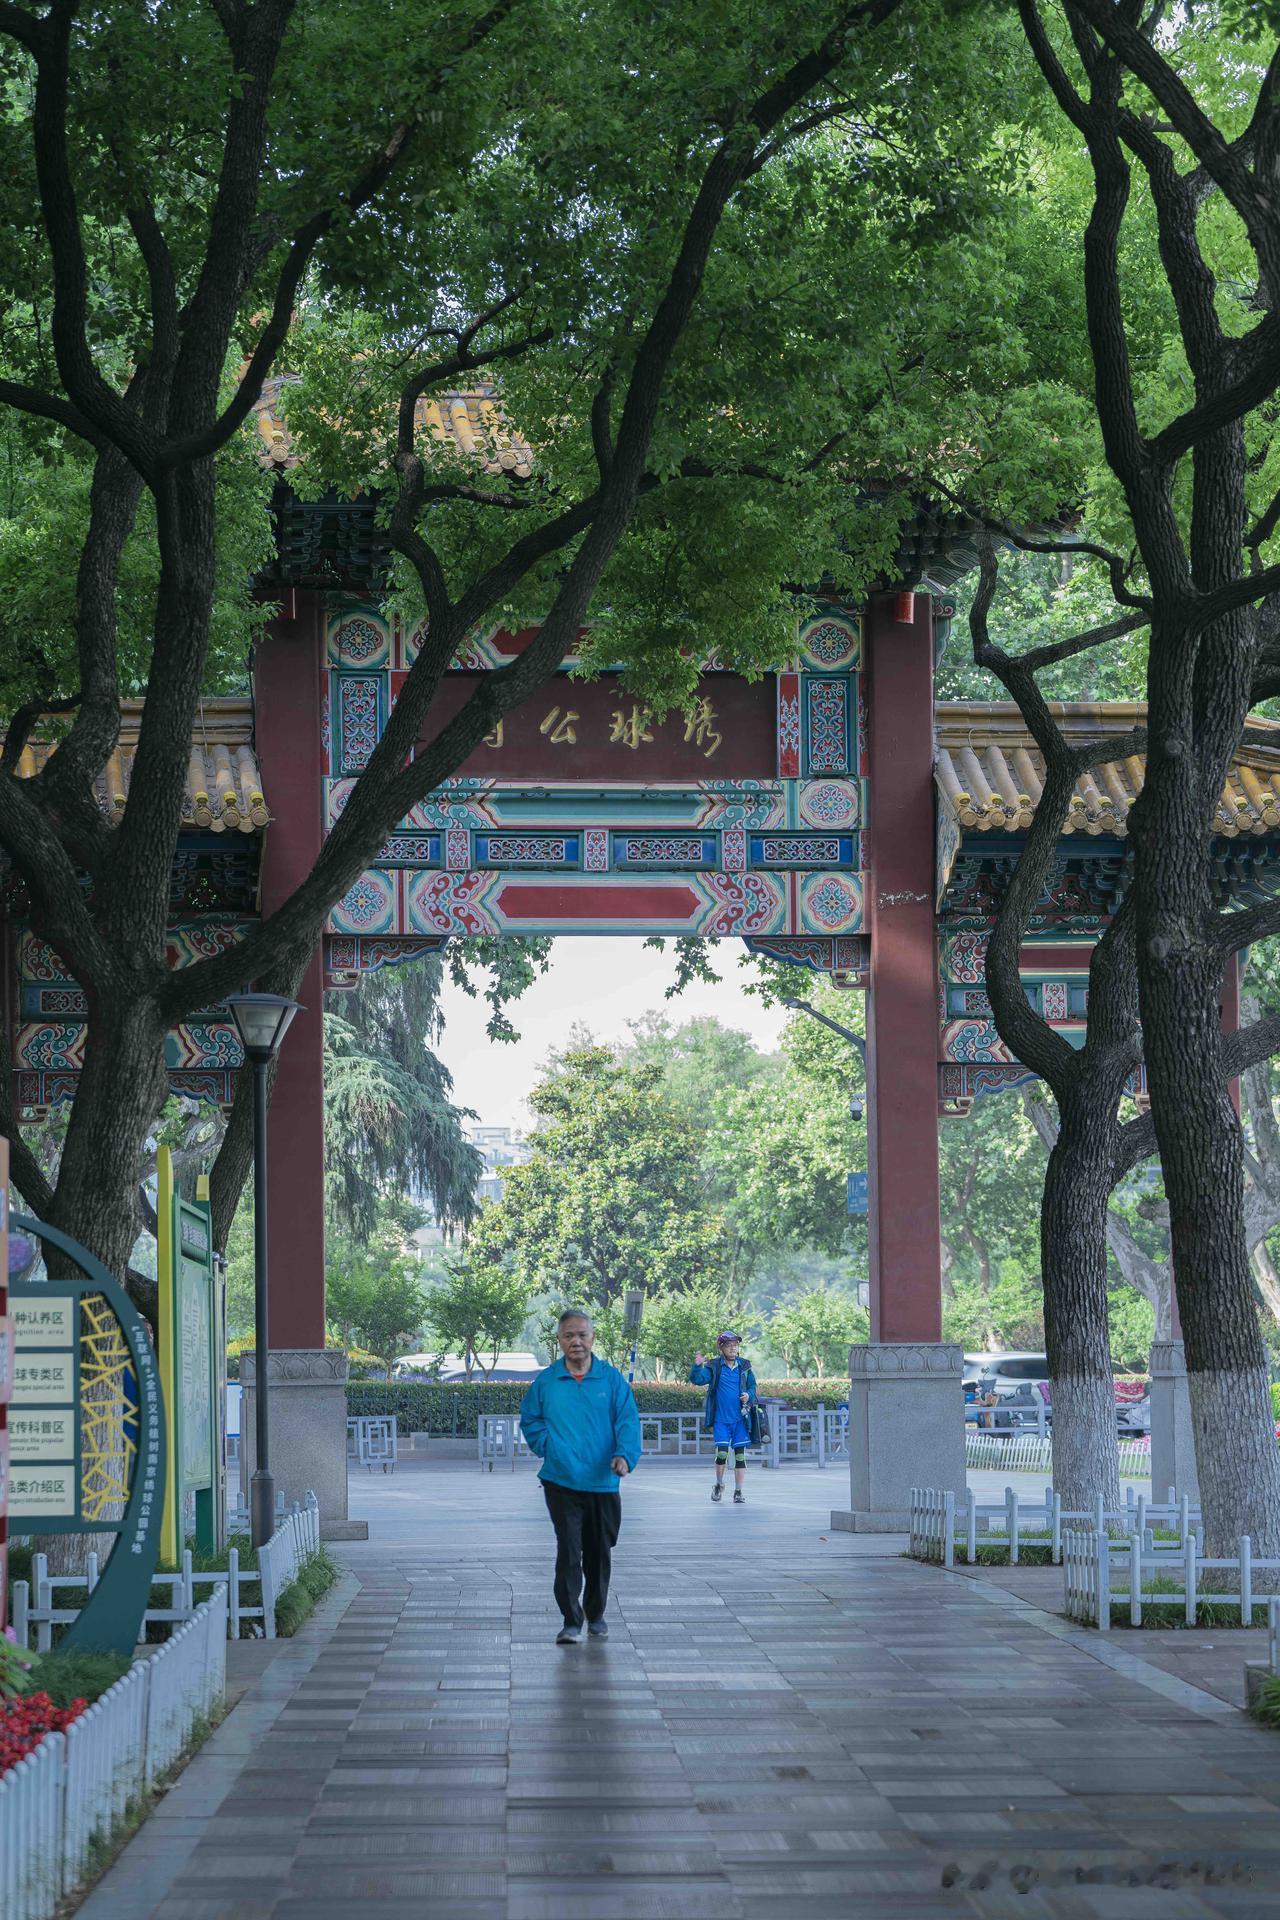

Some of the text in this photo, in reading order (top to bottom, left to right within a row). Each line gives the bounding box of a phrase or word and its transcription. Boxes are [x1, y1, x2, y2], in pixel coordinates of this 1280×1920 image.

[9, 1311, 64, 1324] 种认养区
[11, 1367, 64, 1380] 球专类区
